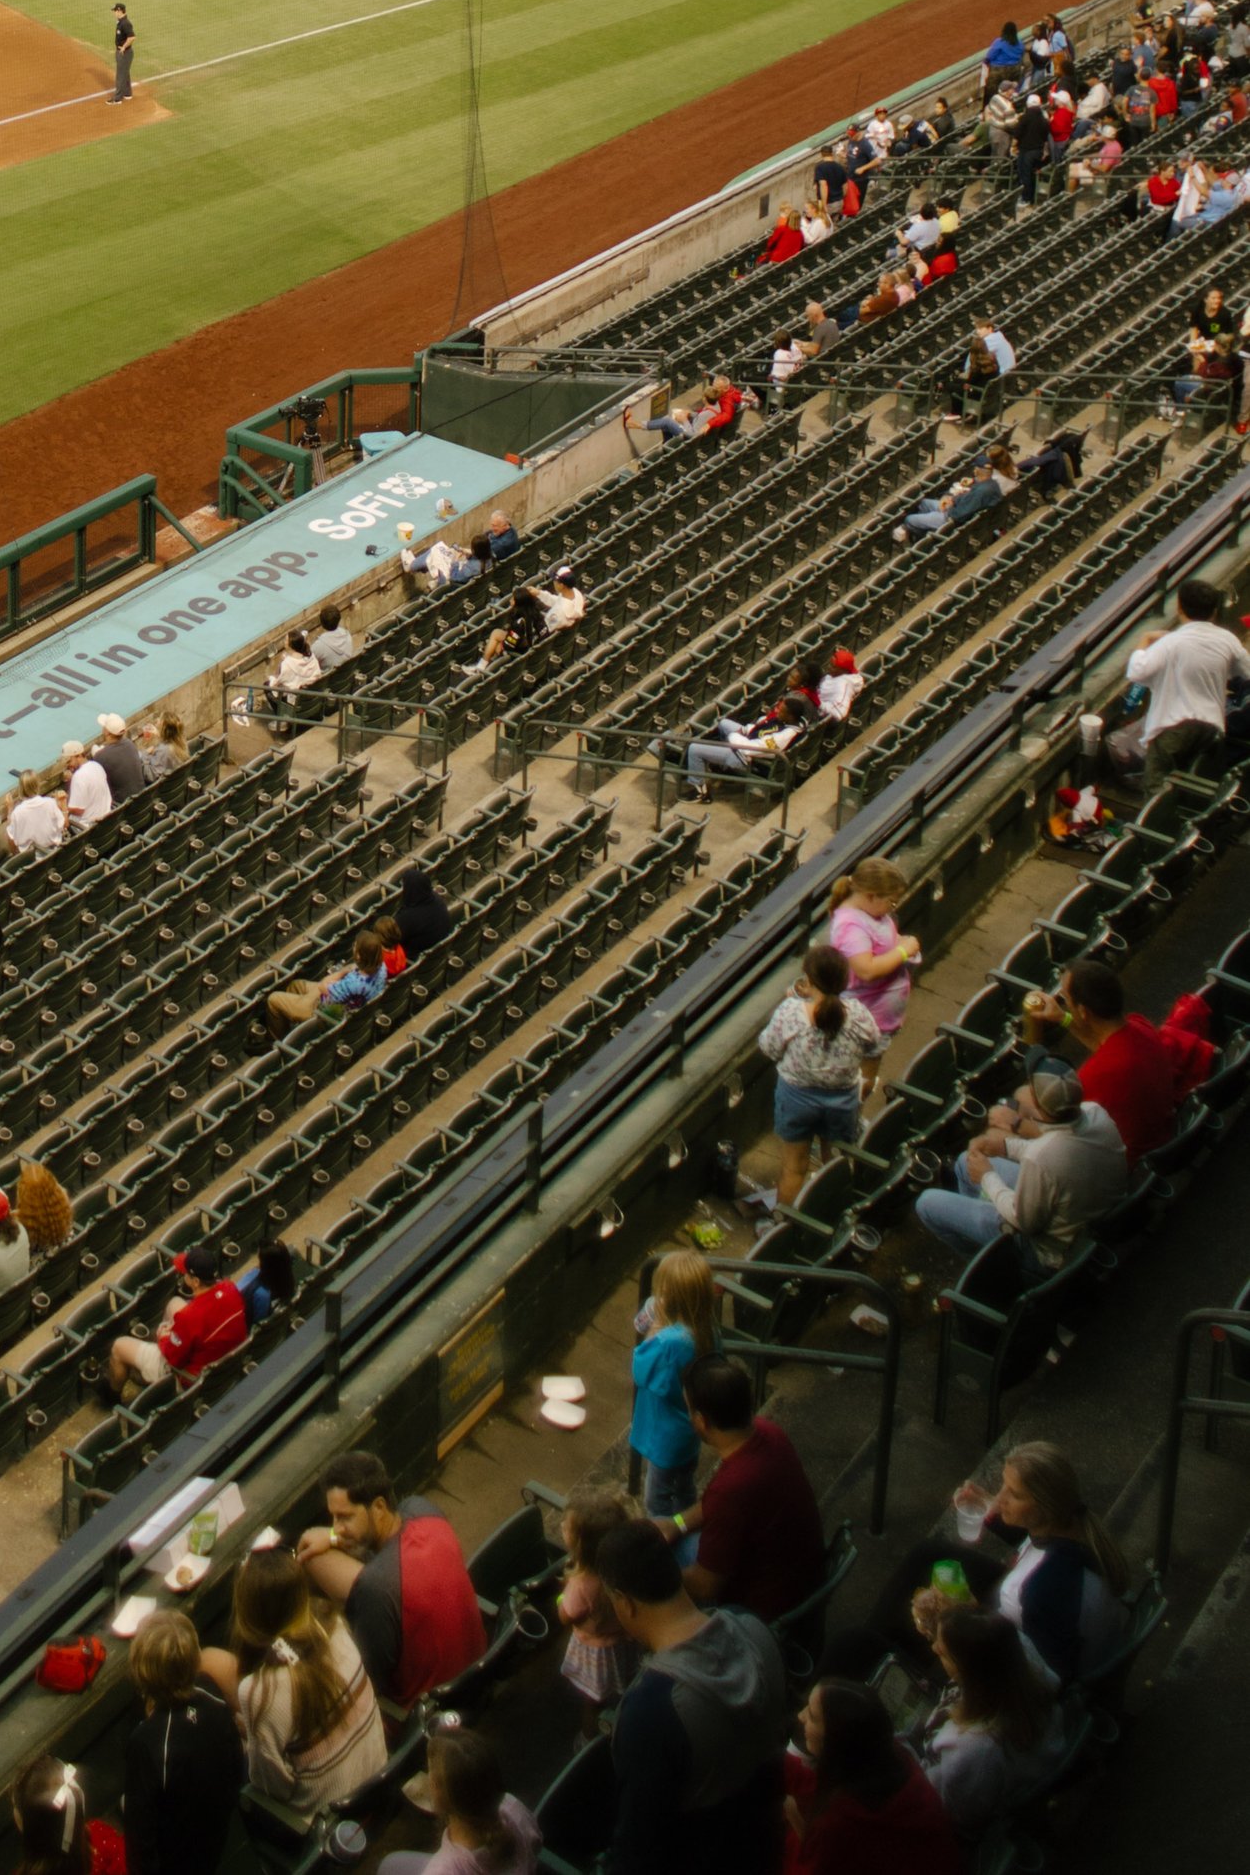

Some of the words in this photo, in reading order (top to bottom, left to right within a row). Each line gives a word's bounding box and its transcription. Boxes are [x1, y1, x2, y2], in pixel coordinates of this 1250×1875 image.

[307, 491, 406, 540] SoFi
[75, 641, 149, 675] in
[137, 595, 227, 645] one
[218, 549, 319, 599] app.
